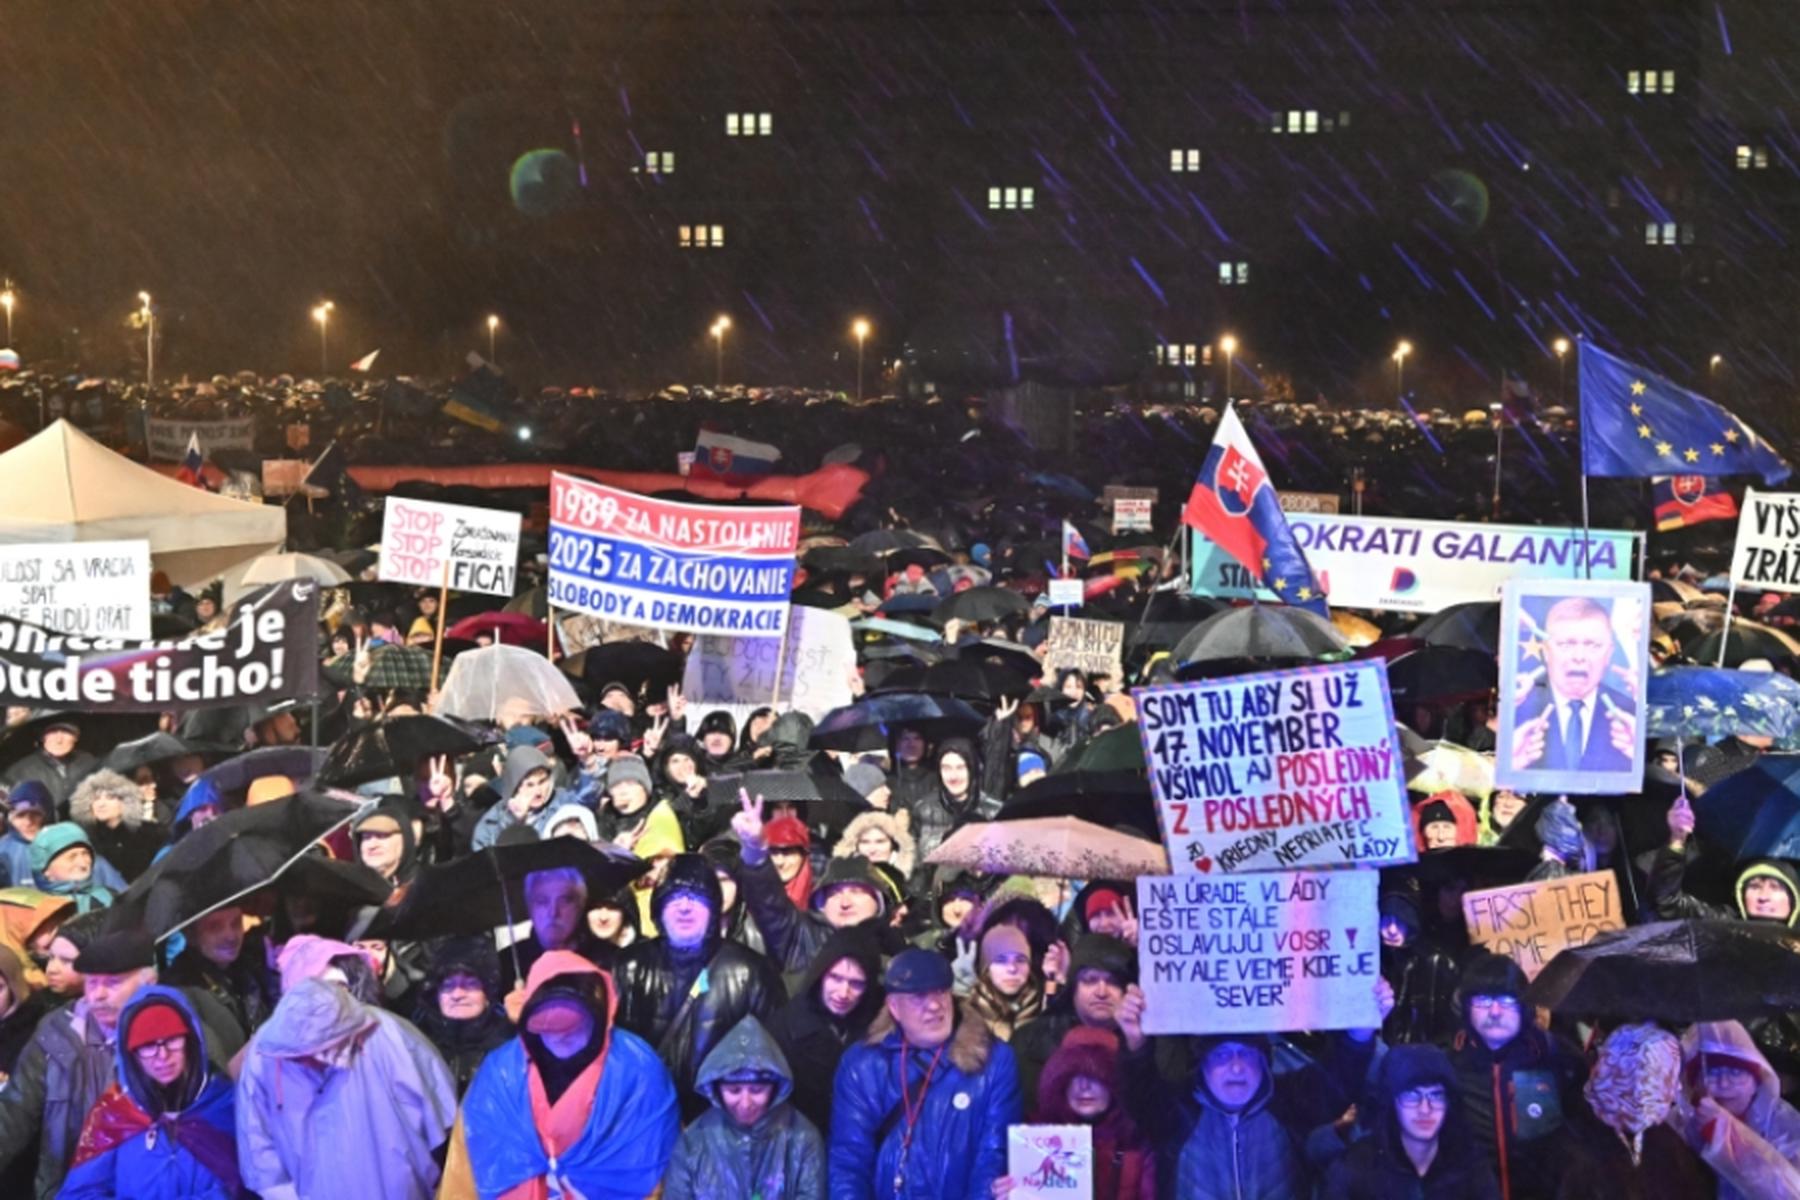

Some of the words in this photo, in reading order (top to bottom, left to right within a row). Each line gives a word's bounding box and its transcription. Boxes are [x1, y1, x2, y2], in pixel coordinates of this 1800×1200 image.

[391, 504, 444, 536] STOP
[555, 484, 619, 529] 1989
[626, 507, 651, 535] ZA
[659, 514, 793, 548] NASTOLENIE
[389, 531, 442, 556] STOP
[1291, 522, 1421, 557] OKRATI
[1432, 531, 1618, 570] GALANTA
[387, 553, 440, 580] STOP
[453, 561, 514, 594] FICA!
[550, 531, 613, 577] 2025
[616, 551, 642, 581] ZA
[647, 555, 788, 595] ZACHOVANIE
[549, 577, 633, 616] SLOBODY
[651, 601, 783, 630] DEMOKRACIE
[235, 603, 285, 659] je
[128, 648, 286, 701] ticho!
[1144, 692, 1199, 730] SOM
[1241, 681, 1282, 719] ABY
[1291, 680, 1315, 712] SI
[1324, 672, 1363, 708] UŽ
[1154, 731, 1191, 765] 17.
[1198, 712, 1343, 761] NOVEMBER
[1157, 761, 1242, 800] VŠIMOL
[1246, 757, 1272, 784] AJ
[1276, 738, 1392, 789] POSLEDNÝ
[1170, 803, 1190, 834] Z
[1339, 837, 1400, 860] VLÁDY
[1150, 883, 1177, 905] NA
[1185, 877, 1247, 904] ÚRADE
[1260, 874, 1330, 902] VLÁDY
[1143, 903, 1200, 930] EŠTE
[1207, 903, 1279, 930] STÁLE
[1471, 889, 1537, 936] FIRST
[1548, 880, 1611, 921] THEY
[1273, 929, 1331, 952] VOSR
[1479, 932, 1548, 964] OME
[1153, 961, 1187, 983] MY
[1190, 958, 1230, 982] ALE
[1302, 954, 1342, 978] KDE
[1346, 952, 1375, 976] JE
